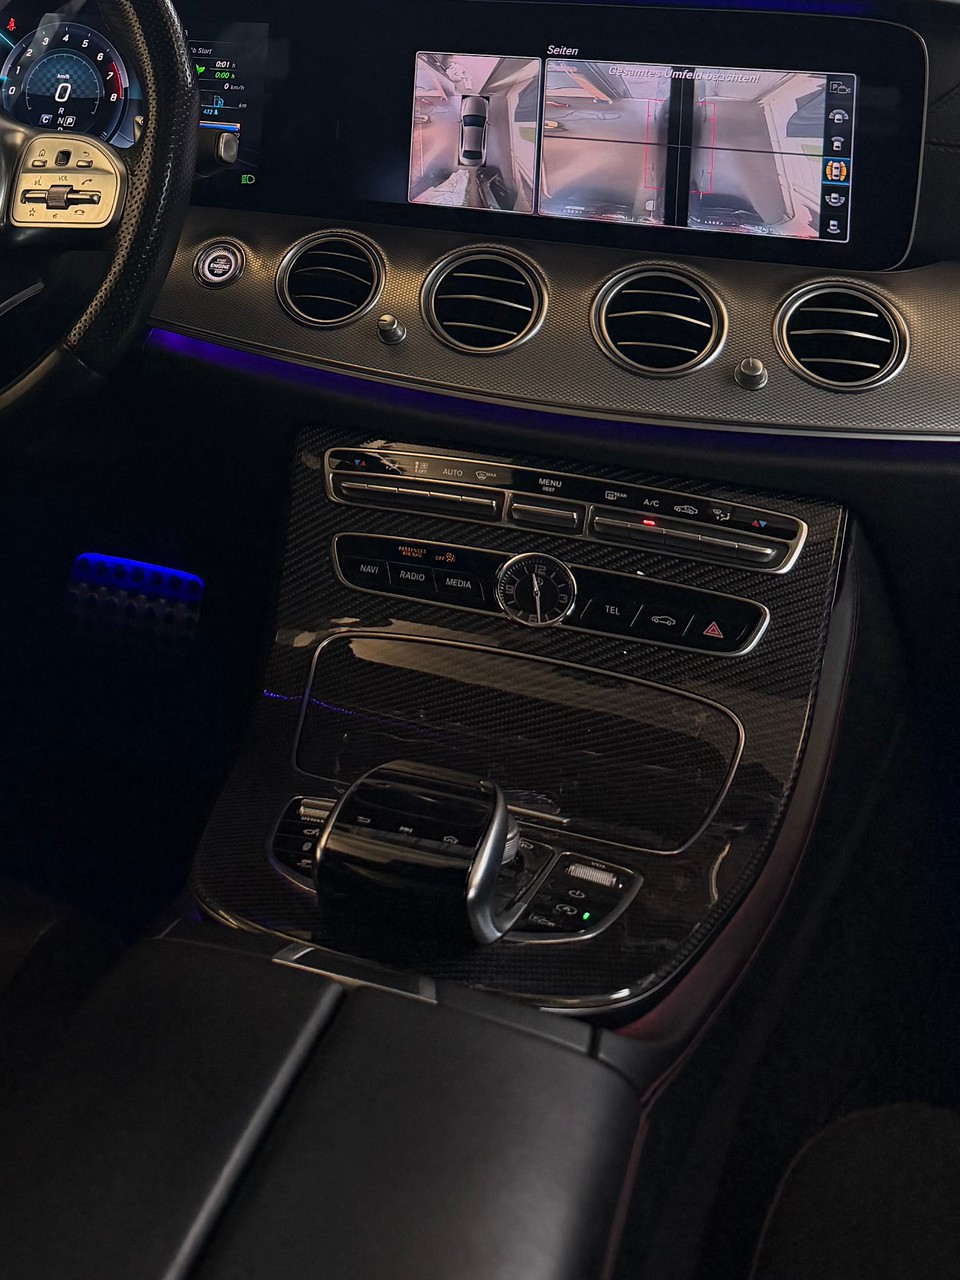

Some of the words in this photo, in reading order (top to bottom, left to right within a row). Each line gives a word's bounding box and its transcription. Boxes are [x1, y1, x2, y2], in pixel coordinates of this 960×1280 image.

[42, 37, 49, 45] 3
[62, 34, 70, 42] 4
[82, 39, 89, 48] 5
[26, 49, 33, 57] 2
[547, 45, 578, 56] Seiten
[96, 52, 104, 61] 6
[15, 66, 20, 74] 1
[608, 66, 661, 78] Gesamtes
[664, 68, 702, 80] Umfeld
[704, 72, 761, 83] beachten!
[106, 72, 114, 81] 7
[8, 86, 16, 95] 0
[54, 82, 72, 102] 0
[110, 93, 117, 102] 8
[57, 117, 64, 125] N
[442, 468, 463, 477] AUTO
[538, 478, 562, 488] MENU
[643, 498, 660, 508] A/C
[360, 564, 379, 574] NAVI
[534, 564, 546, 574] 12
[399, 570, 426, 582] RADIO
[445, 578, 472, 589] MEDIA
[505, 584, 514, 594] 9
[560, 594, 568, 603] 3
[604, 604, 621, 616] TEL
